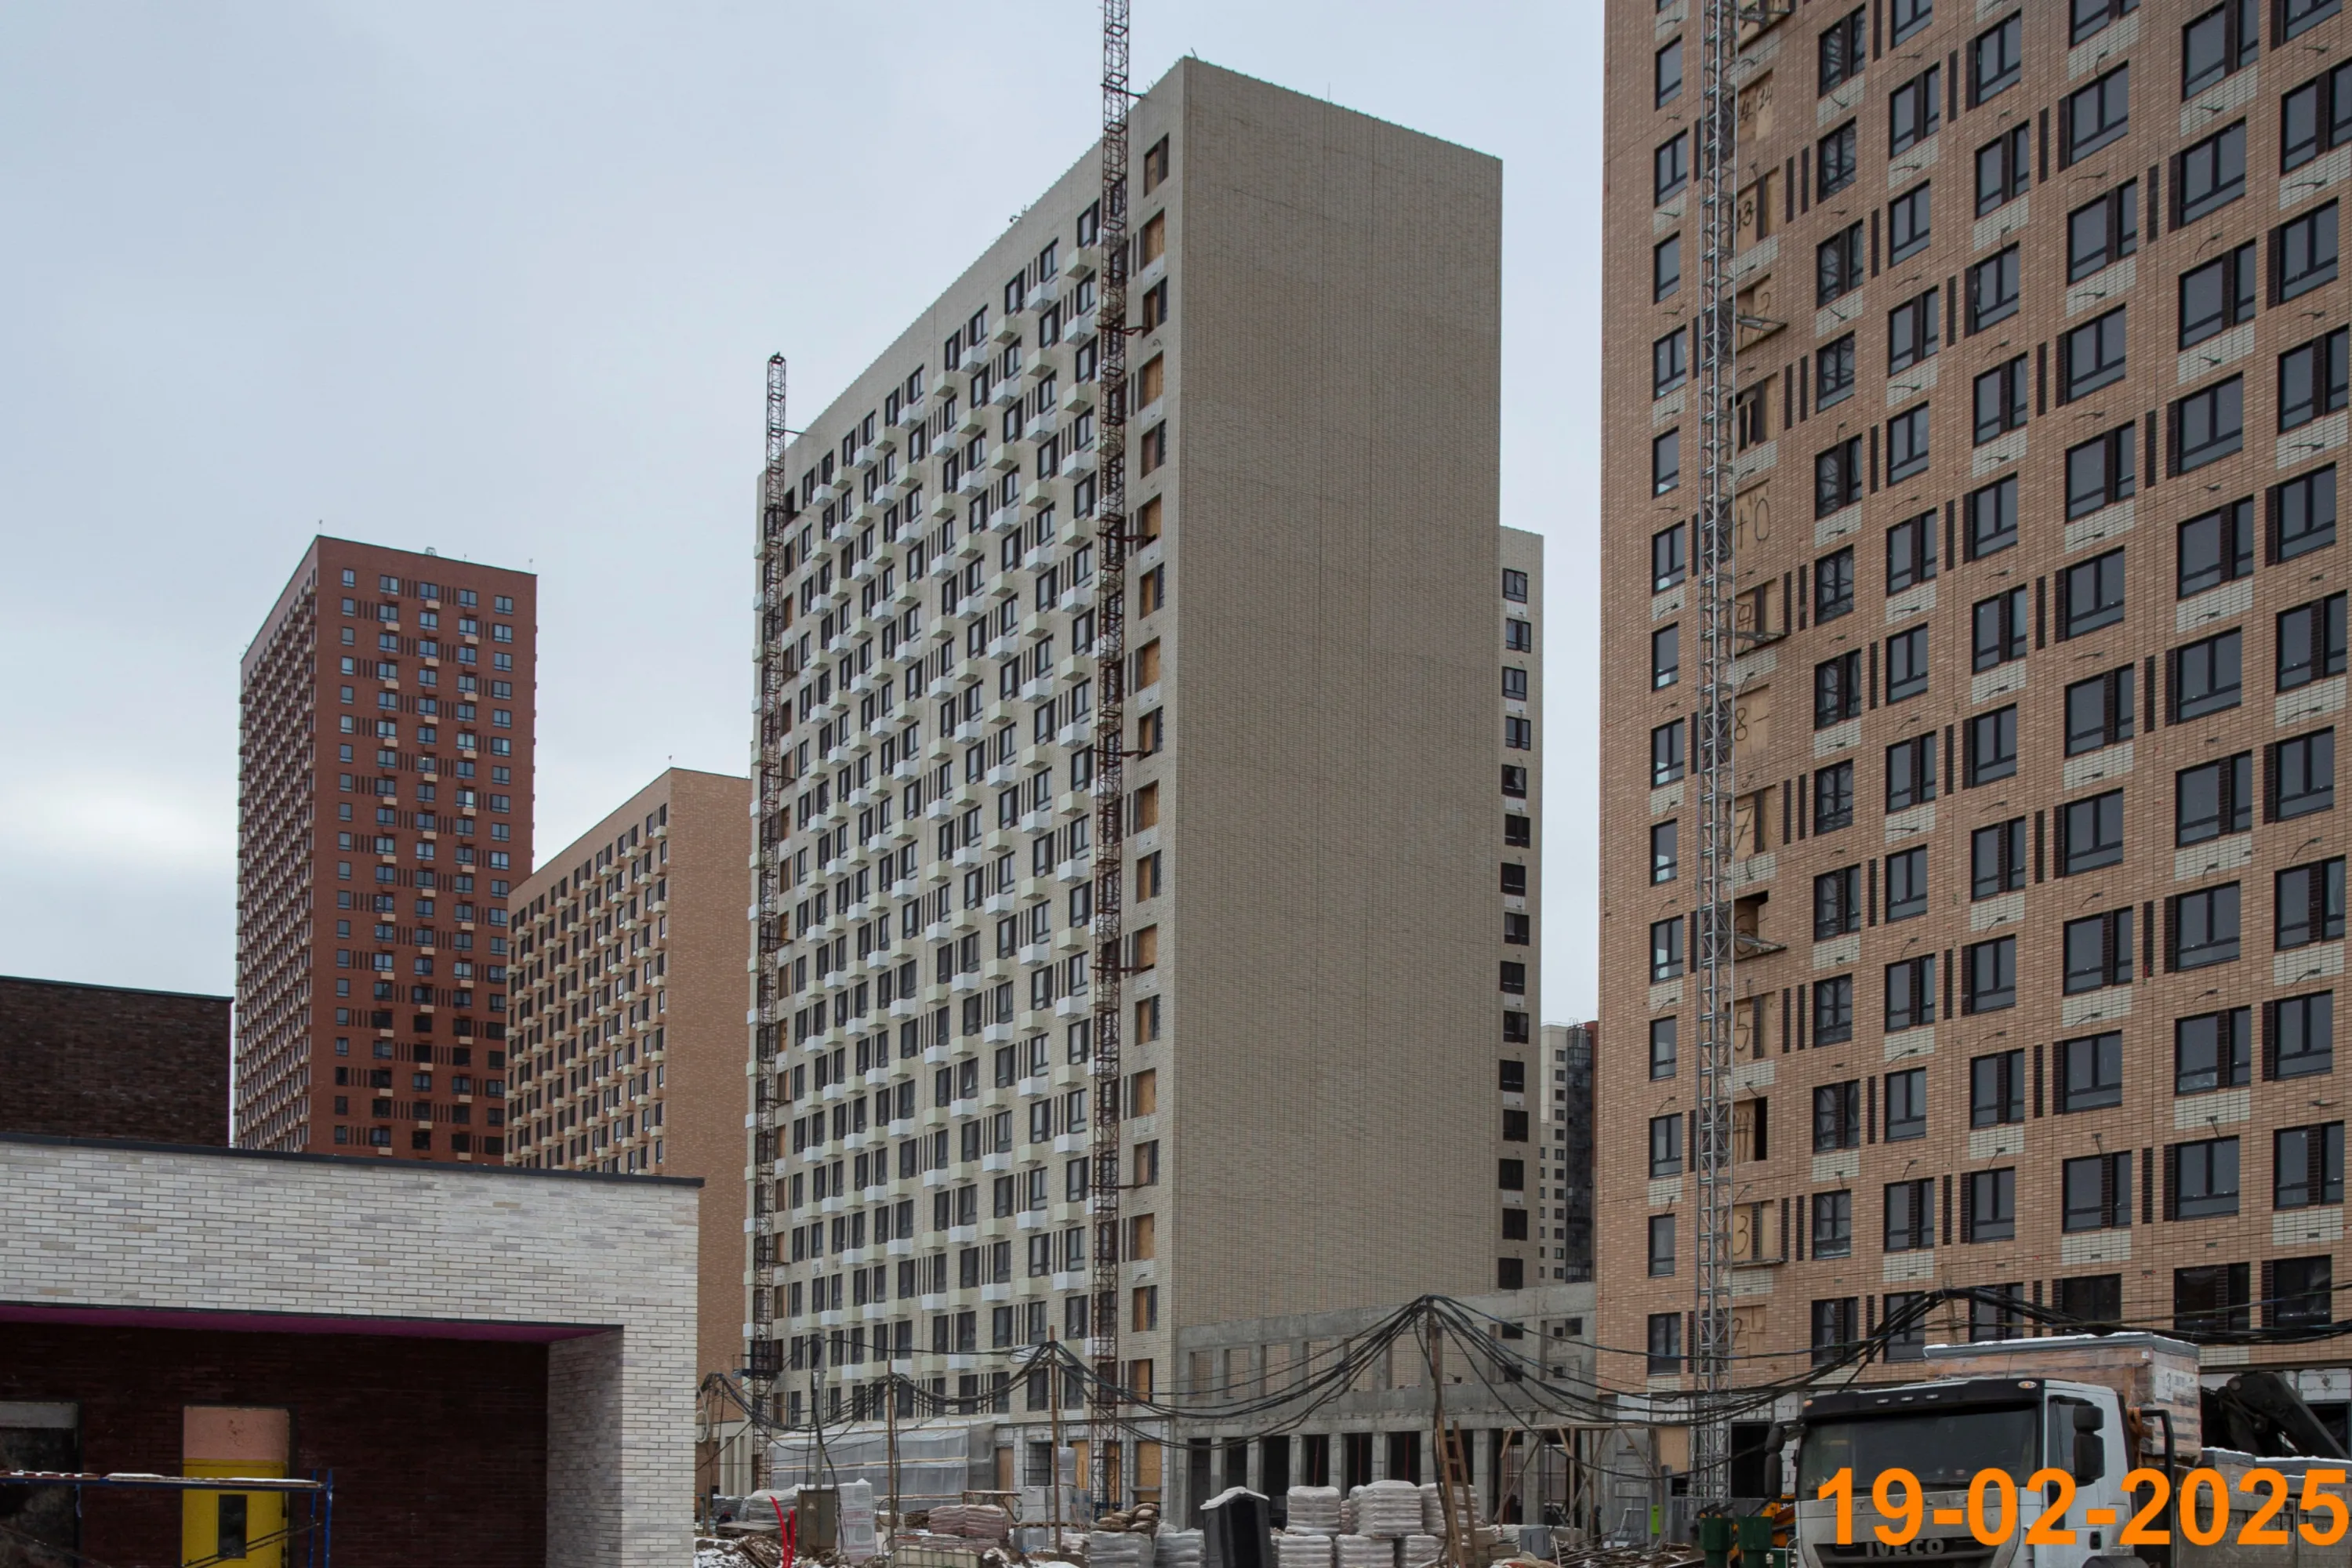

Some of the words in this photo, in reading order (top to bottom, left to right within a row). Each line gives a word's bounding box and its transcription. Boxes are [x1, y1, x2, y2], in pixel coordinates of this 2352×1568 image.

[1735, 707, 1748, 742] 8
[1733, 805, 1754, 851] 7
[1735, 1008, 1752, 1051] 5
[1734, 1214, 1749, 1256] 3
[1867, 1538, 1944, 1558] IVECO
